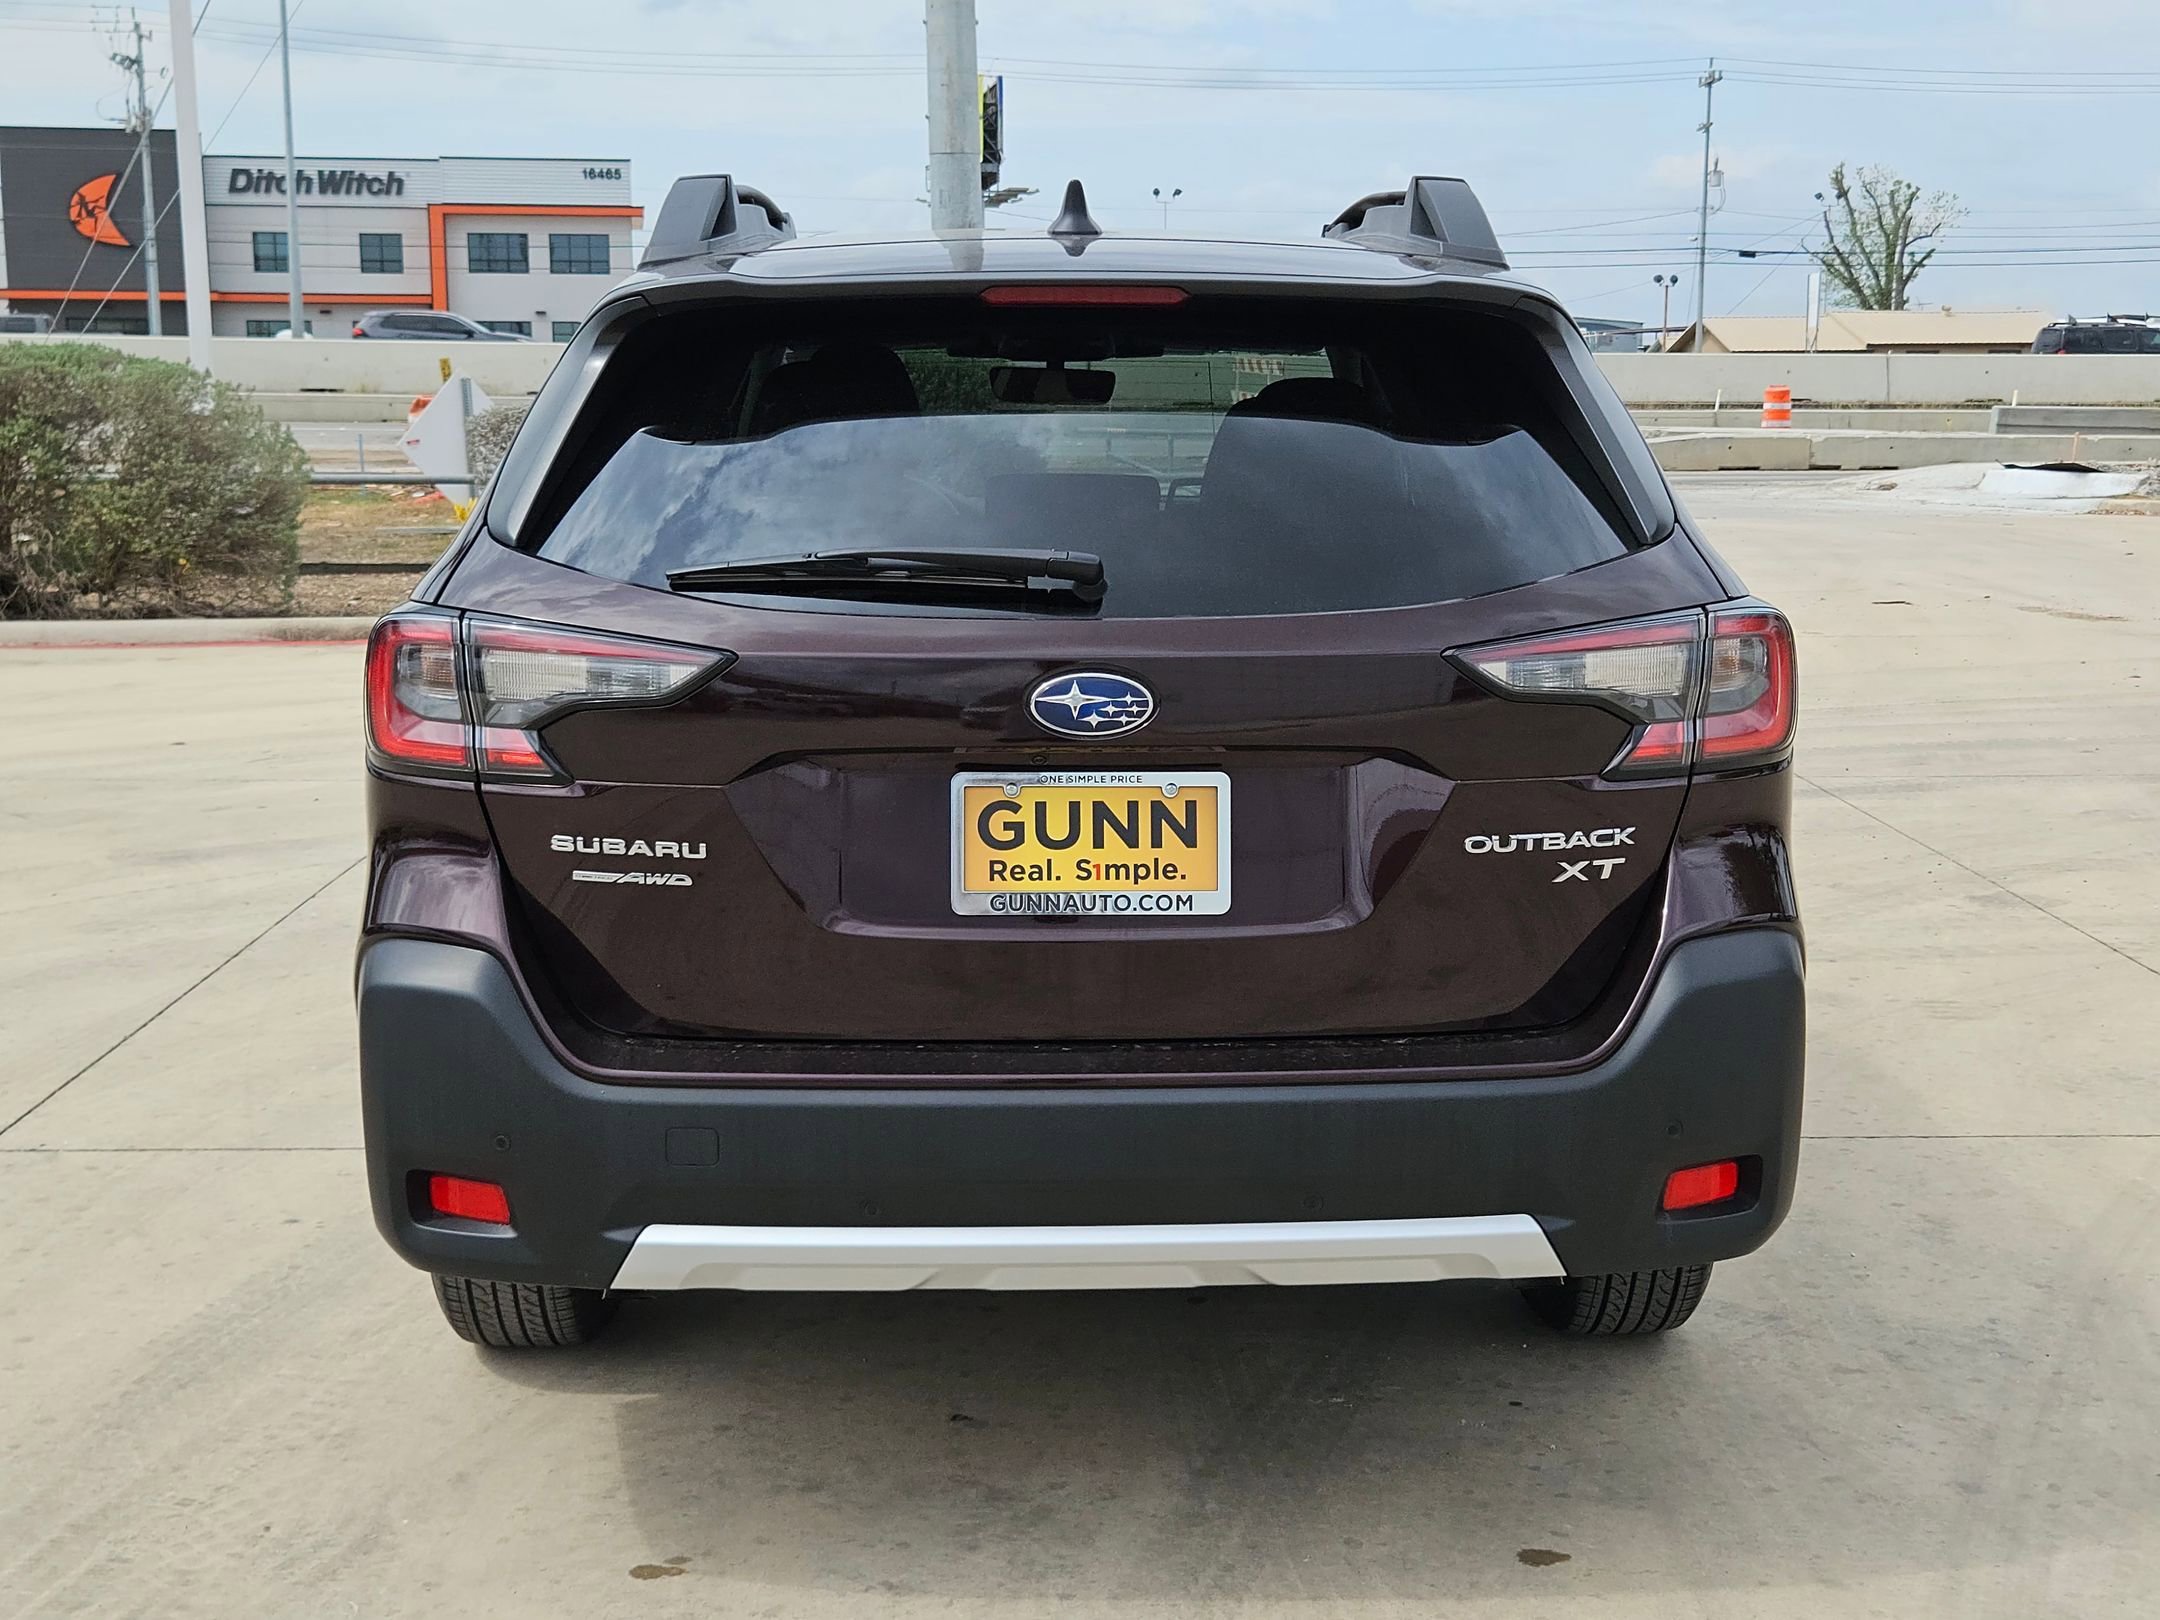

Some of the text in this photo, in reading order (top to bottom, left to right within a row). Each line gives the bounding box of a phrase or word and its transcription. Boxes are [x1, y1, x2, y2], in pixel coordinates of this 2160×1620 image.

[317, 170, 405, 196] Witch
[582, 168, 622, 181] 16465
[1040, 775, 1143, 784] ONE SIMPLE PRICE
[977, 799, 1198, 851] GUNN
[550, 834, 707, 859] SUBARU
[1464, 826, 1636, 855] OUTBACK
[616, 872, 693, 887] AWD
[988, 858, 1062, 882] Real.
[1551, 857, 1627, 883] XT
[989, 893, 1194, 913] GUNNAUTO.COM
